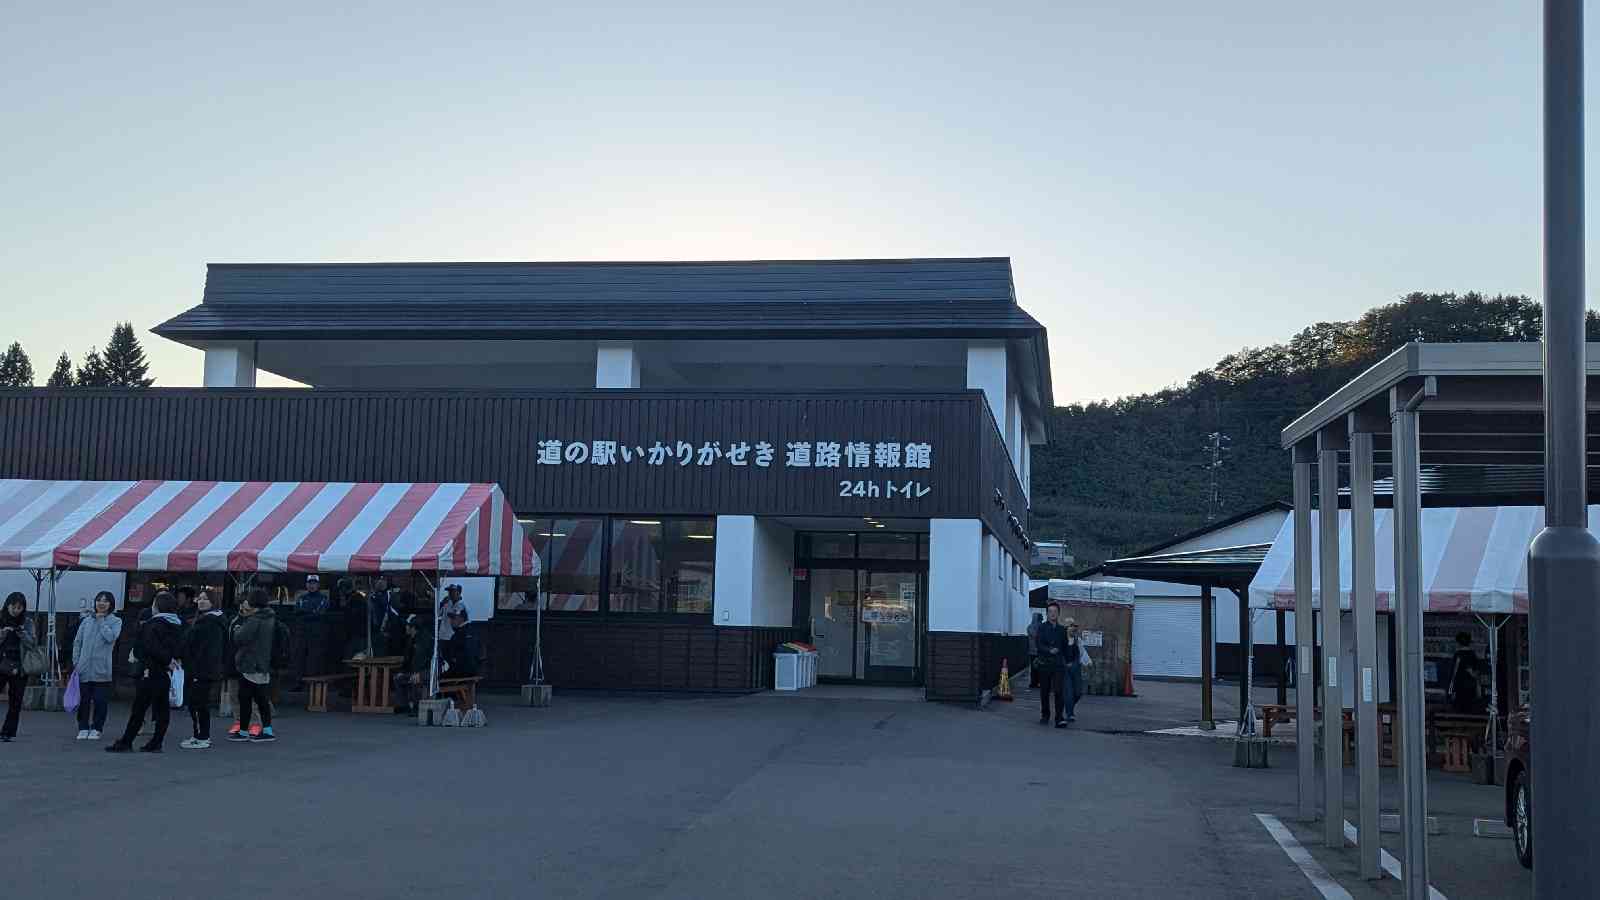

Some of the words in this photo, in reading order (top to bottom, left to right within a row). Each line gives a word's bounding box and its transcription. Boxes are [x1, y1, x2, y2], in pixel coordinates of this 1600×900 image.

[536, 440, 776, 467] 道の駅いかりがせき
[785, 441, 932, 469] 道路情報館
